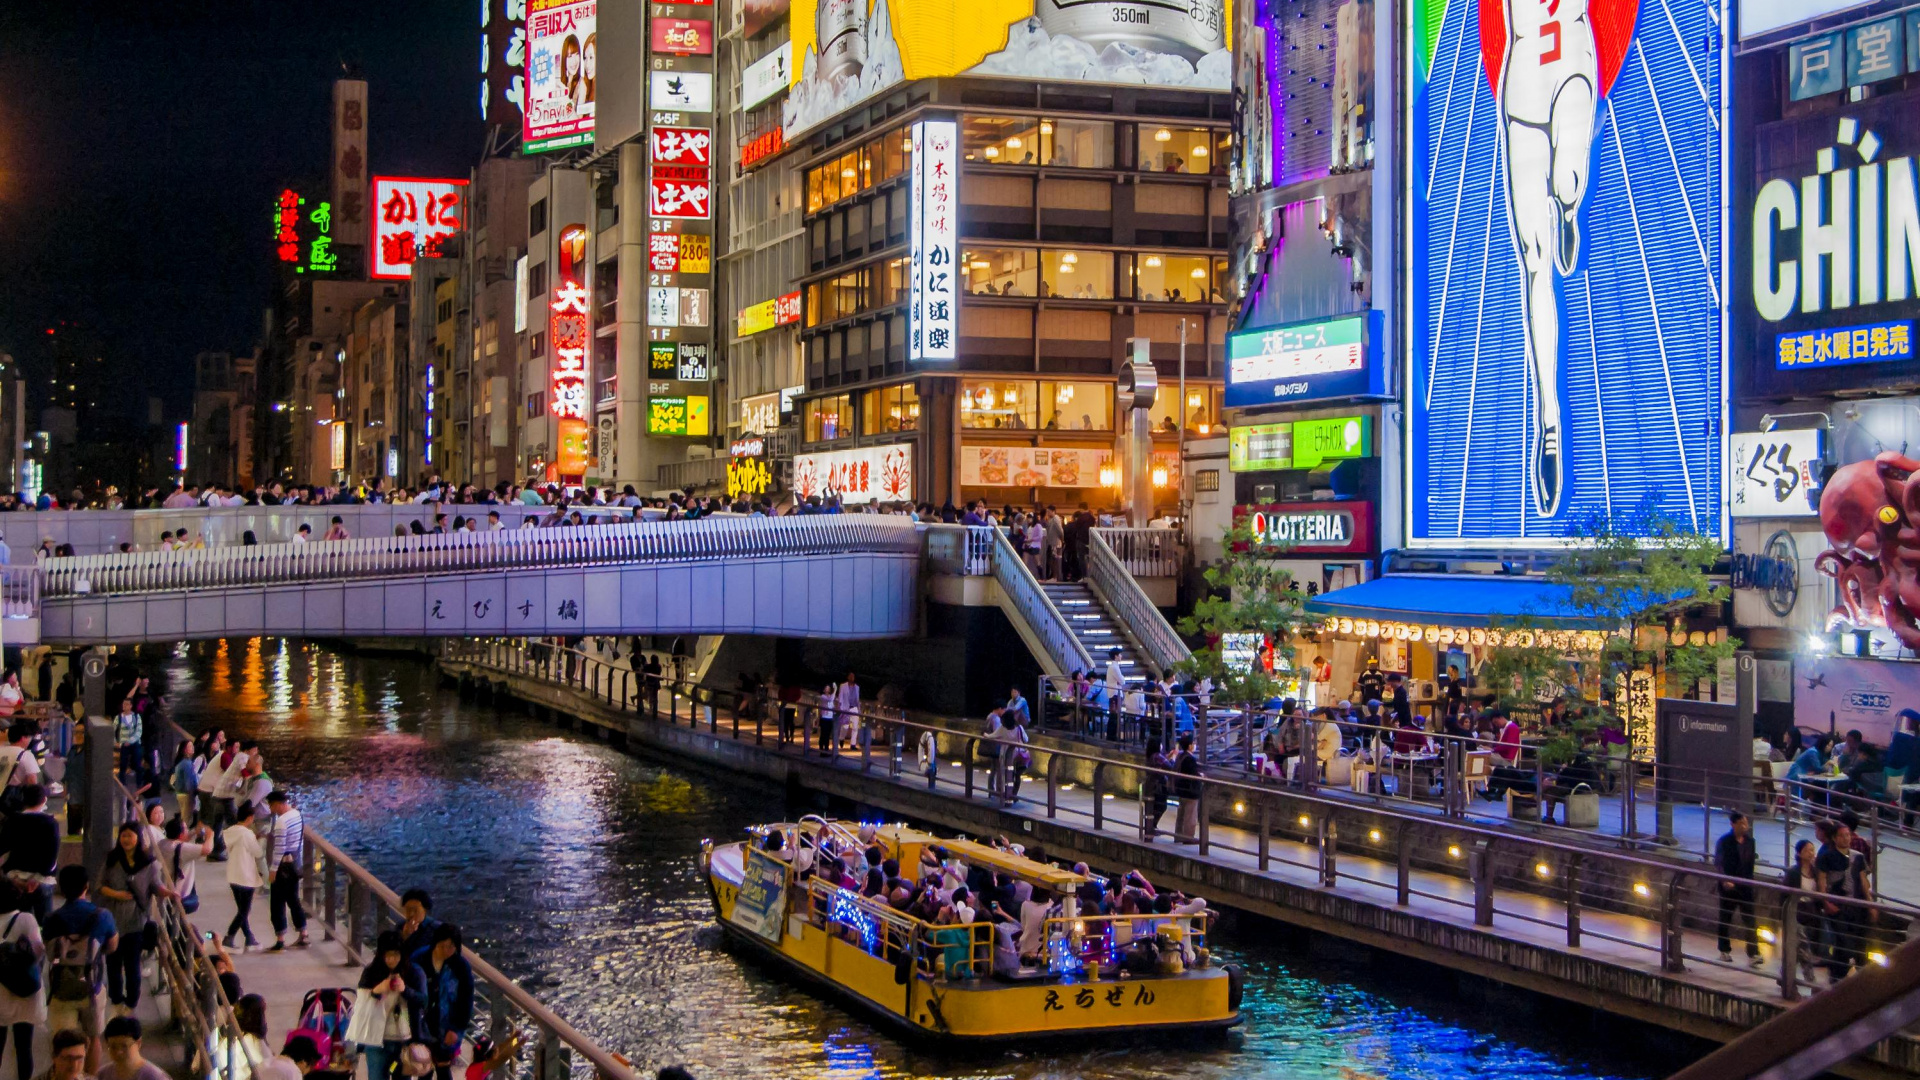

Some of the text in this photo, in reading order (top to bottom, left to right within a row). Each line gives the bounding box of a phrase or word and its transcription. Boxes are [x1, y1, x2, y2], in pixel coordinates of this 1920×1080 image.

[534, 8, 577, 39] 高収入
[1112, 7, 1150, 25] 350ml
[664, 28, 700, 47] 和民
[653, 131, 710, 162] はや
[382, 188, 460, 229] かに
[652, 183, 709, 214] はや
[681, 244, 709, 260] 280円
[1262, 326, 1327, 355] 大阪ニュース
[1778, 324, 1909, 366] 毎週水曜日発売
[681, 345, 706, 357] 珈琲
[681, 364, 706, 379] 青山
[689, 357, 698, 366] の
[652, 405, 684, 420] びっくり
[650, 418, 686, 432] ドンキー
[1268, 514, 1344, 541] LOTTERIA
[431, 599, 578, 621] えびす橋
[1690, 720, 1727, 732] information
[1044, 984, 1155, 1011] えちぜん
